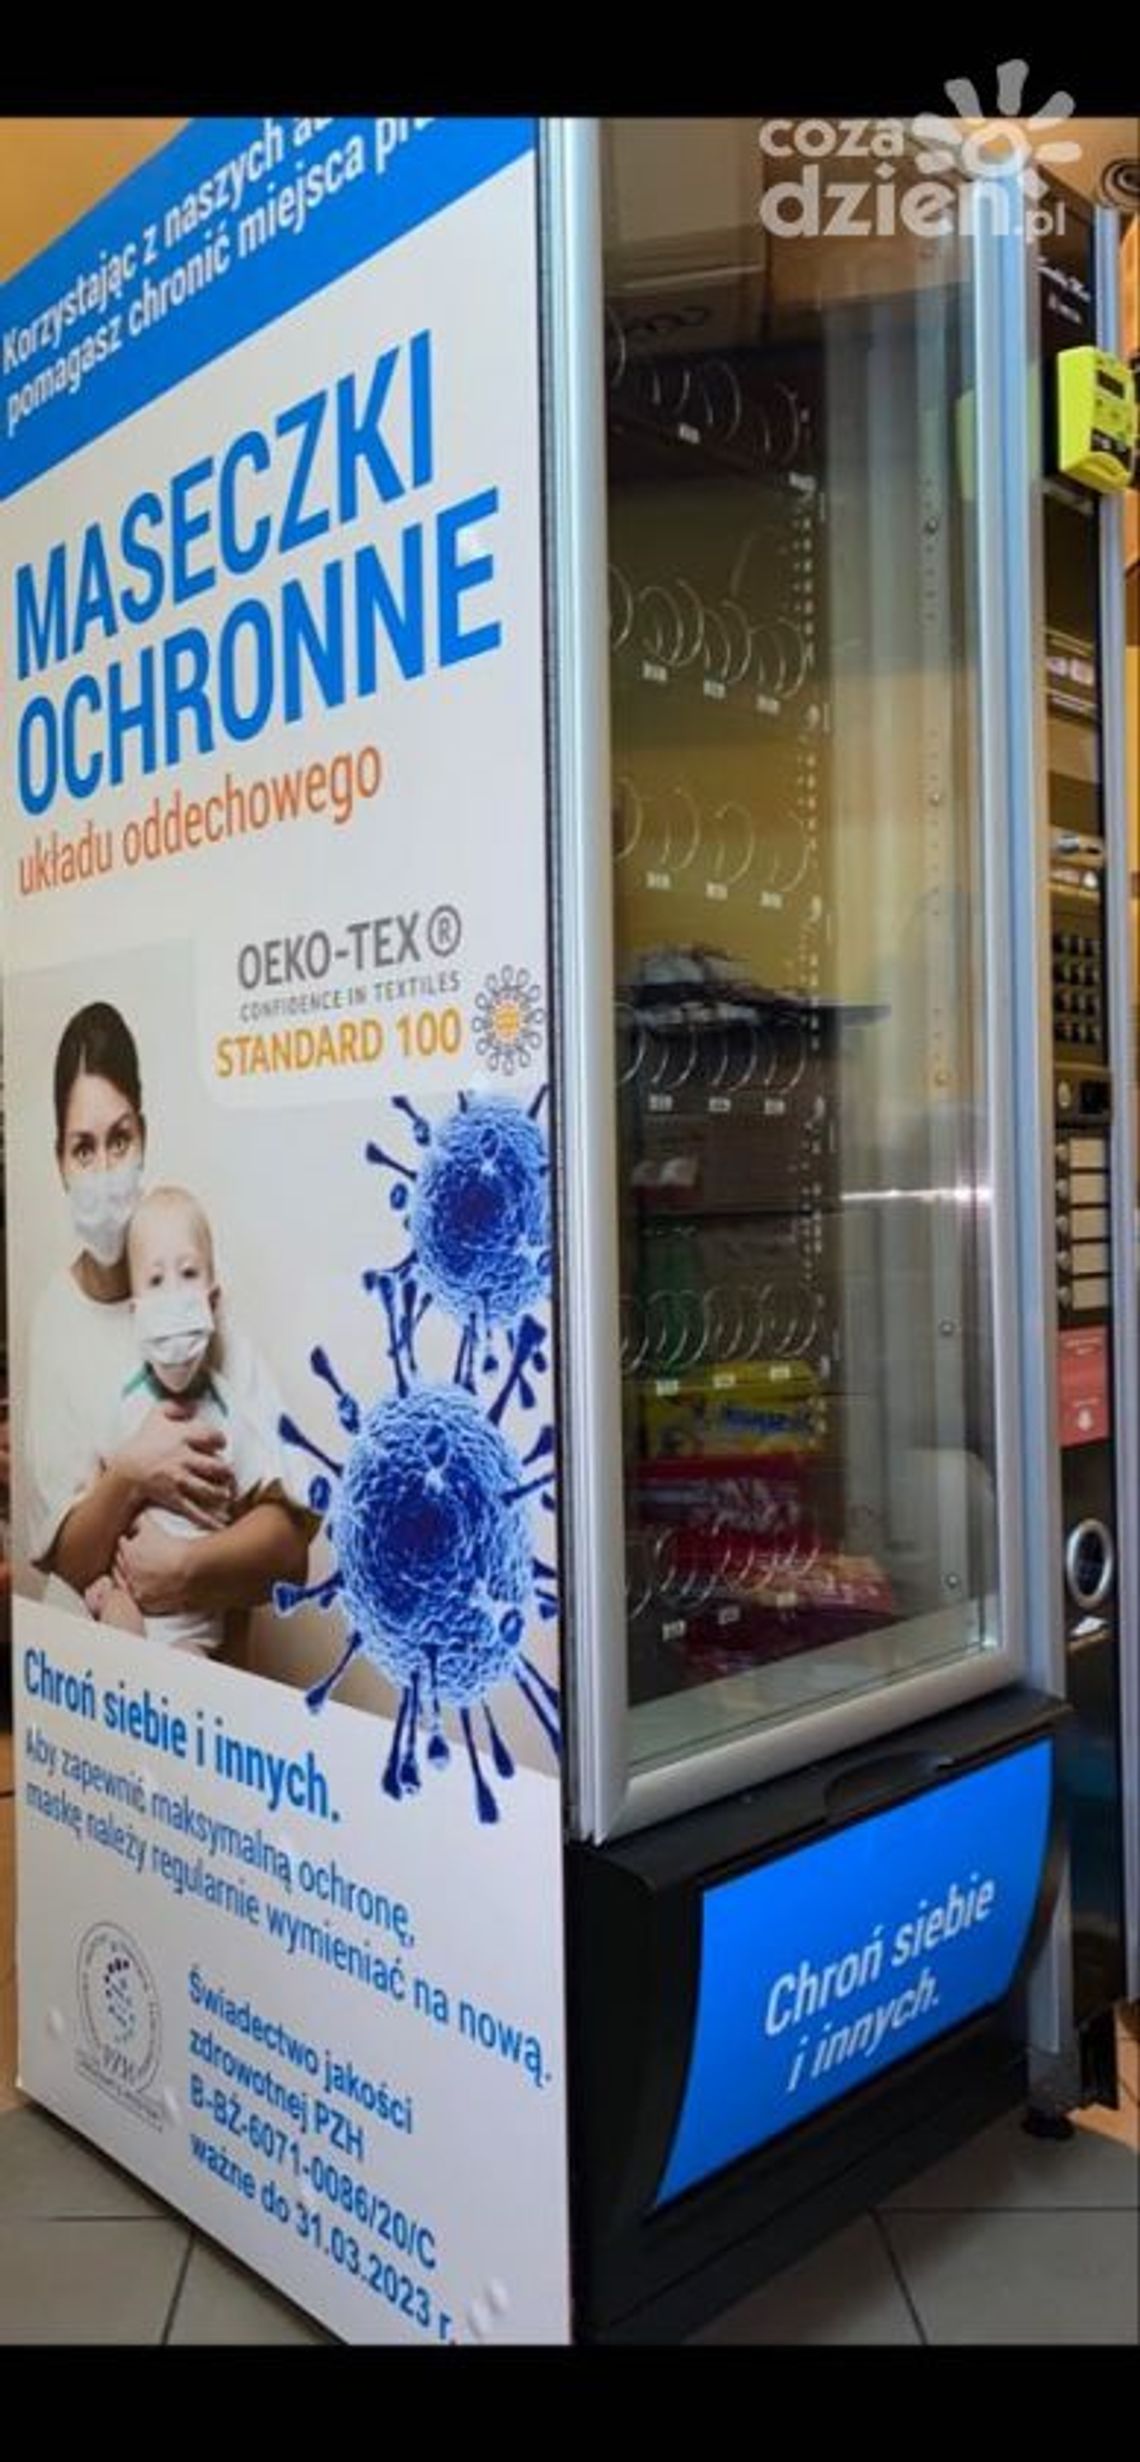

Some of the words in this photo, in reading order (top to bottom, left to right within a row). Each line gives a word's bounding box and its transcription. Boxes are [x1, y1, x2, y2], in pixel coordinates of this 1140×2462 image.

[3, 243, 137, 375] Korzystając
[143, 224, 158, 265] z
[164, 117, 284, 248] naszych
[8, 314, 122, 438] pomagasz
[129, 219, 230, 337] chronić
[238, 135, 365, 259] miejsca
[15, 329, 433, 681] MASECZKI
[18, 486, 501, 816] OCHRONNE
[19, 819, 113, 895] układu
[122, 745, 382, 867] oddechowego
[216, 1018, 384, 1078] STANDARD
[396, 1007, 462, 1058] 100
[240, 990, 342, 1022] CONFIDENCE
[348, 984, 367, 1006] IN
[373, 970, 461, 1002] TEXTILES
[24, 1647, 96, 1720] Chroń
[104, 1679, 188, 1759] siebie
[196, 1711, 205, 1767] i
[215, 1716, 341, 1822] innych.
[26, 1727, 57, 1778] Aby
[61, 1749, 146, 1813] zapewnić
[150, 1794, 293, 1894] maksymalną
[300, 1860, 415, 1946] ochronę,
[26, 1781, 82, 1838] maskę
[86, 1812, 147, 1873] należy
[152, 1846, 260, 1925] regularnie
[266, 1902, 405, 2000] wymieniać
[413, 1979, 448, 2023] na
[459, 2000, 552, 2088] nową.
[765, 1923, 885, 2036] Chroń
[891, 1870, 996, 1967] siebie
[188, 1963, 319, 2075] Świadectwo
[325, 2049, 413, 2134] jakości
[189, 2028, 307, 2134] zdrowotnej
[313, 2099, 364, 2162] PZH
[787, 2034, 809, 2093] i
[810, 1965, 940, 2079] innych.
[189, 2132, 256, 2200] ważne
[260, 2177, 290, 2223] do
[295, 2202, 431, 2328] 31.03.2023
